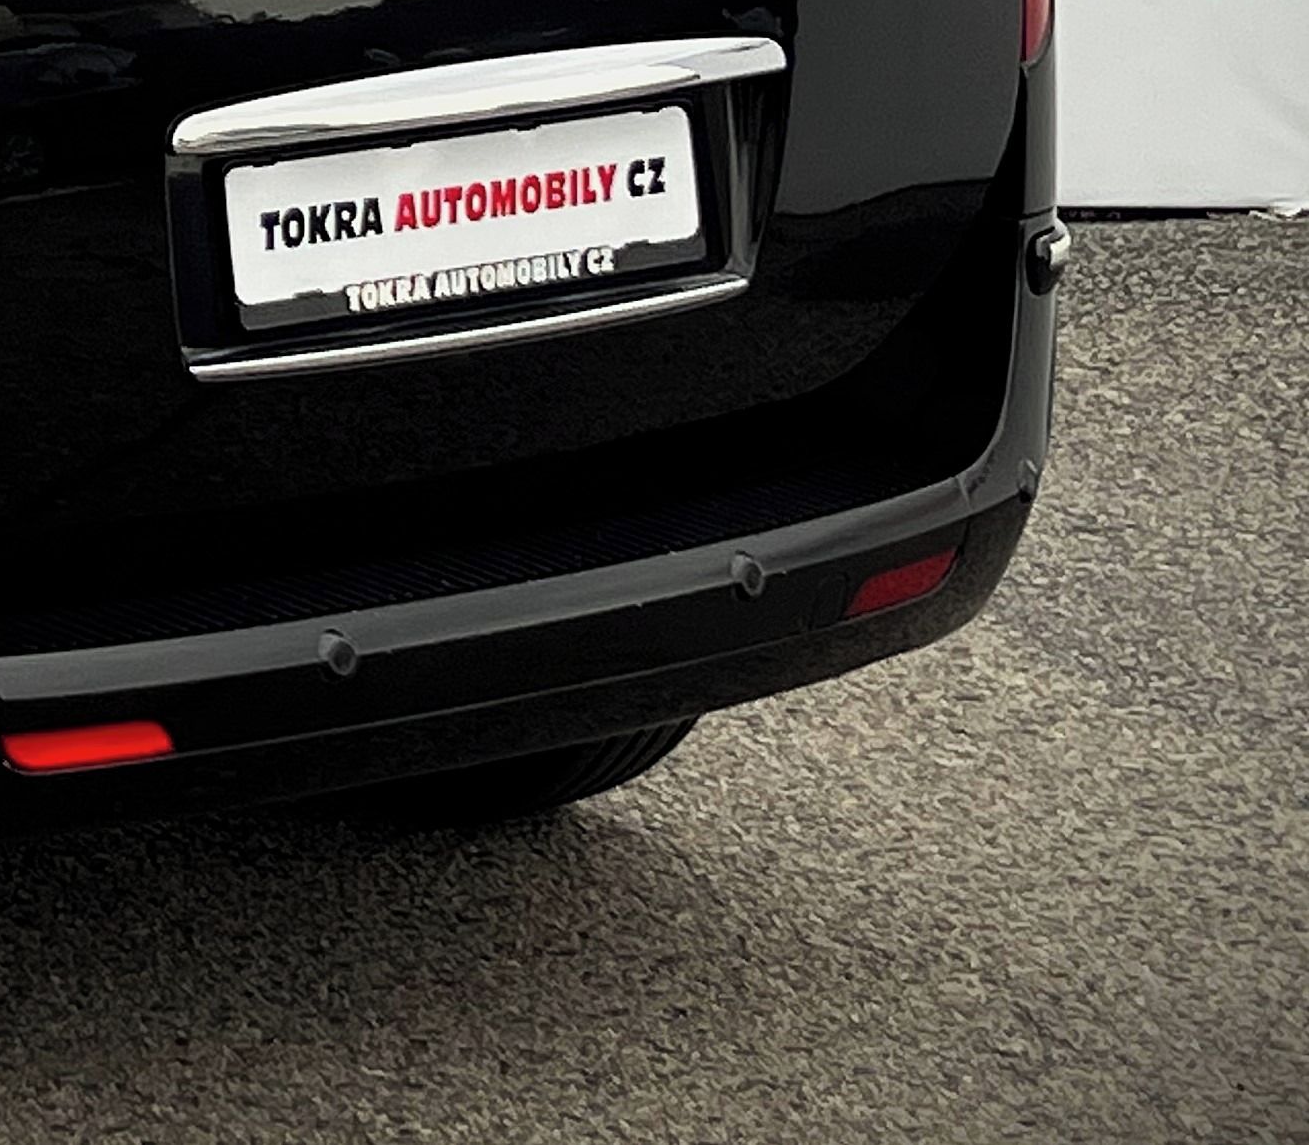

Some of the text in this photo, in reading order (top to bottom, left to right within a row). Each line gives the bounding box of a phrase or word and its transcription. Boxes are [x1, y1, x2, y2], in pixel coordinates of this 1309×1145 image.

[260, 156, 666, 251] TOKRA AUTOMOBILY CZ
[345, 245, 615, 312] TOKRA AUTOMOBILY CZ
